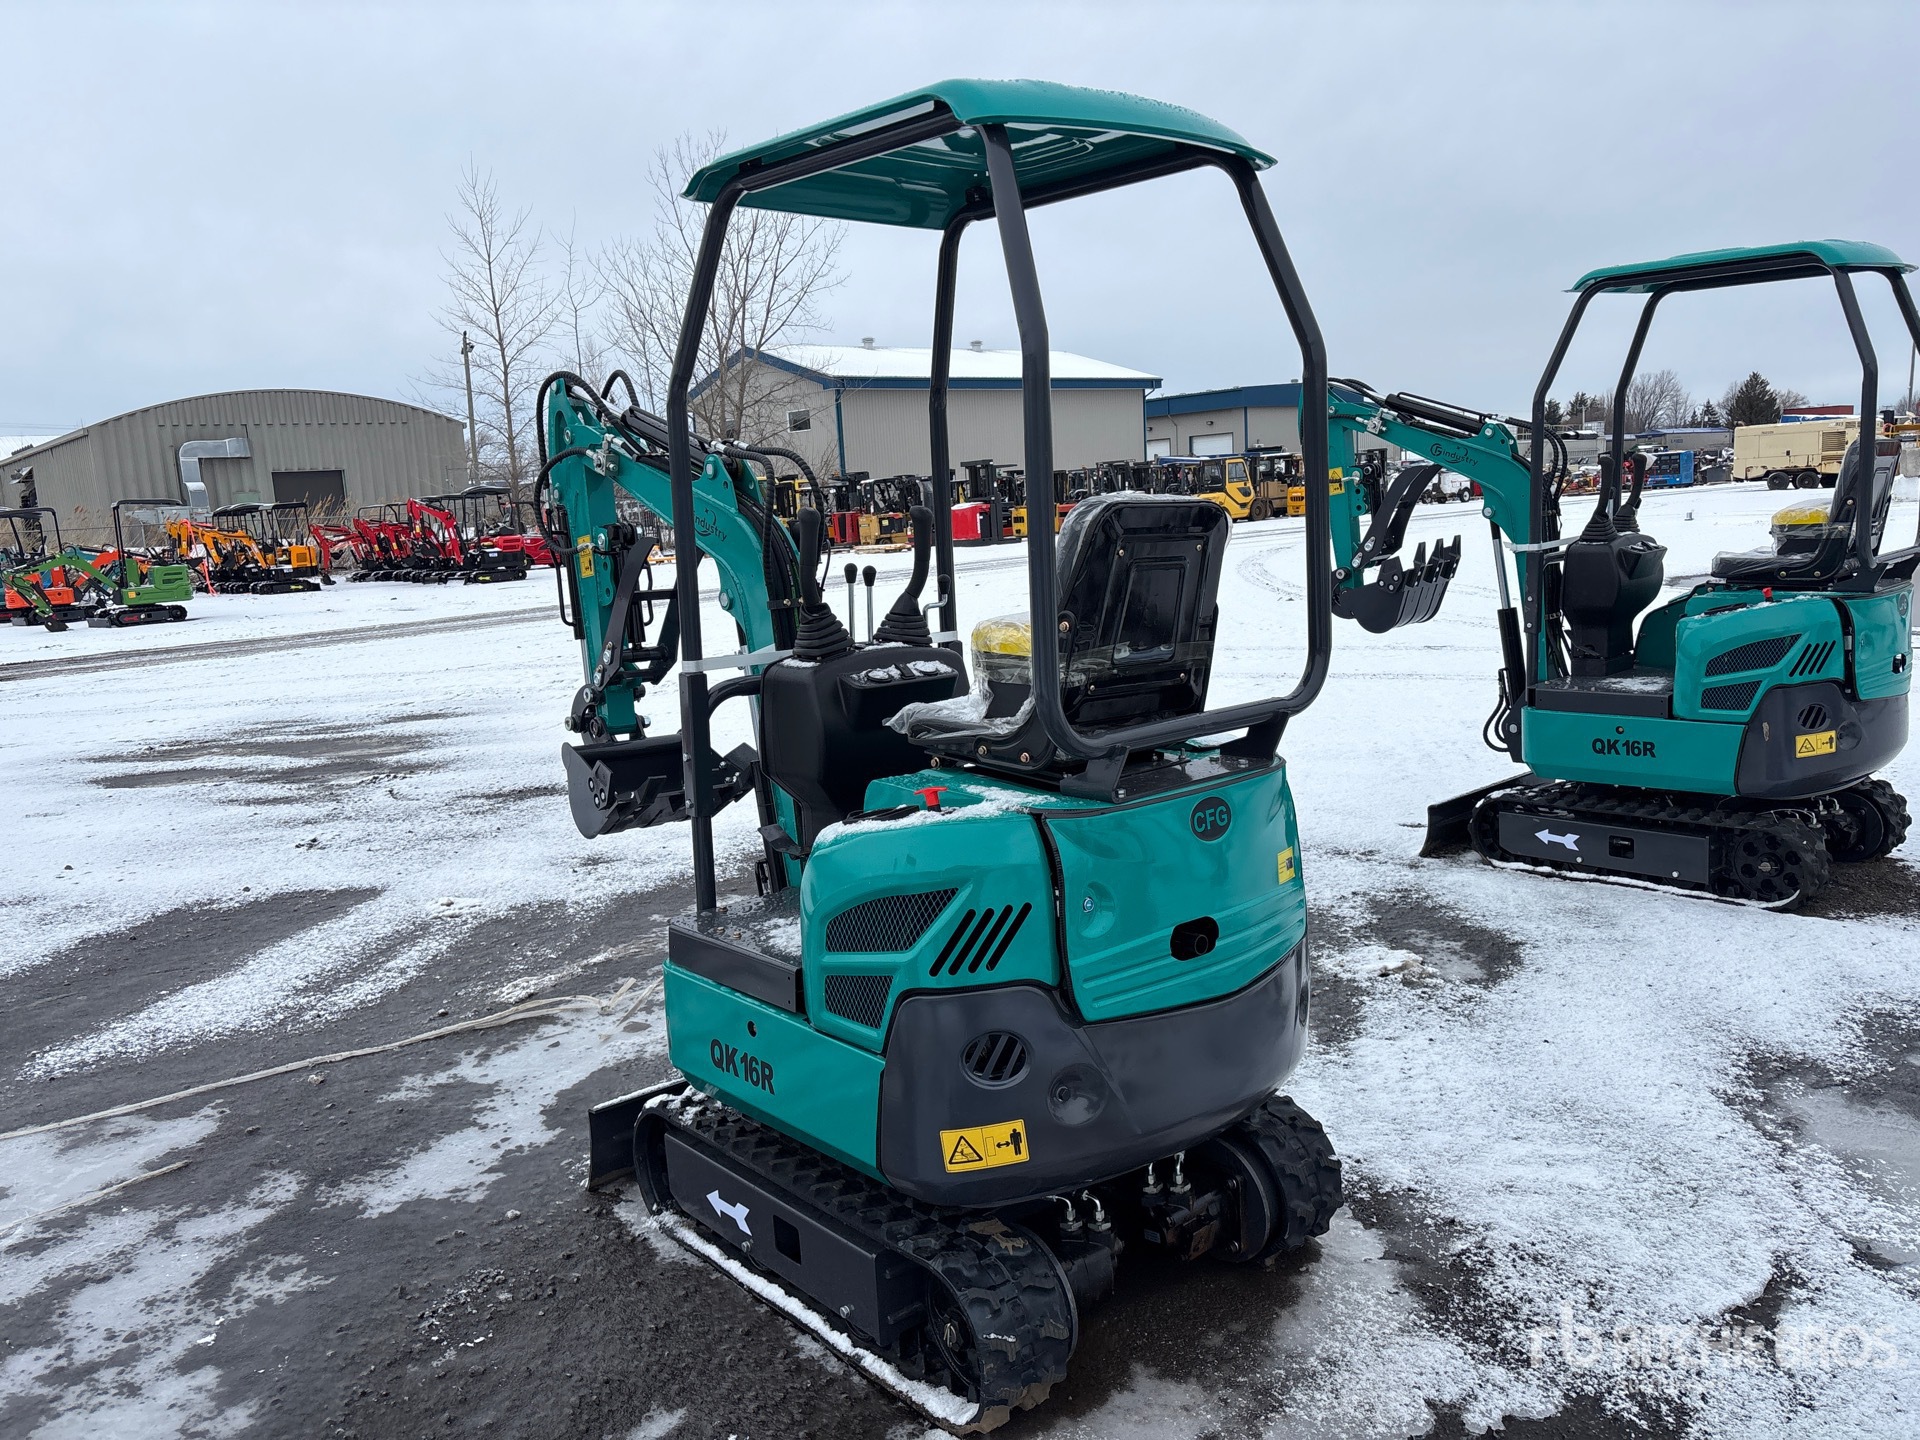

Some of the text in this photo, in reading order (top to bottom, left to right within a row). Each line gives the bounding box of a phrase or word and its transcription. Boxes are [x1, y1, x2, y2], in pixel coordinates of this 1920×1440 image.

[1443, 450, 1479, 466] industry
[694, 511, 728, 542] ndustry
[1591, 738, 1656, 758] QK16R
[1193, 805, 1228, 833] CFG
[710, 1038, 775, 1096] QK16R
